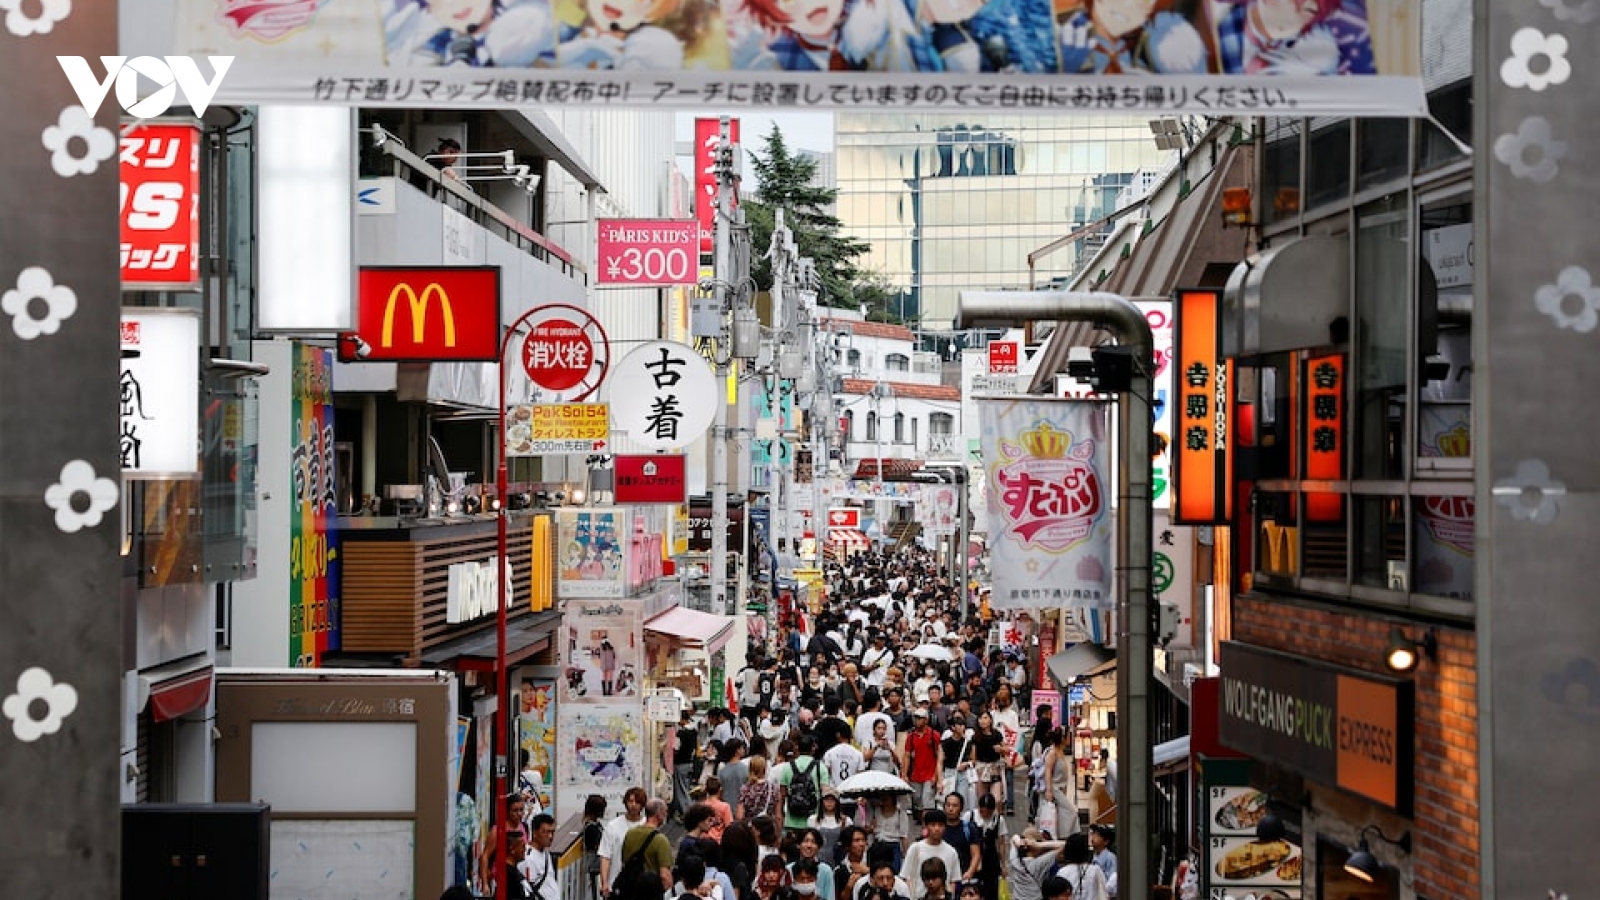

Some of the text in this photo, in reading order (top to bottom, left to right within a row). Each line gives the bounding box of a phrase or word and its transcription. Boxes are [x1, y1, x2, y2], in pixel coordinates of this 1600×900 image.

[609, 226, 649, 243] PARIS
[652, 230, 689, 243] KID'S
[607, 248, 688, 280] ¥300
[528, 341, 588, 369] 消火栓
[643, 347, 686, 441] 古着
[1186, 361, 1209, 451] 吉野家
[1215, 363, 1226, 450] YOSHINOYA
[533, 405, 606, 418] Pak Soi 54
[534, 428, 607, 439] タイレストラン
[1224, 677, 1394, 767] WOLFGANG PUCK EXPRESS
[839, 761, 849, 781] 8
